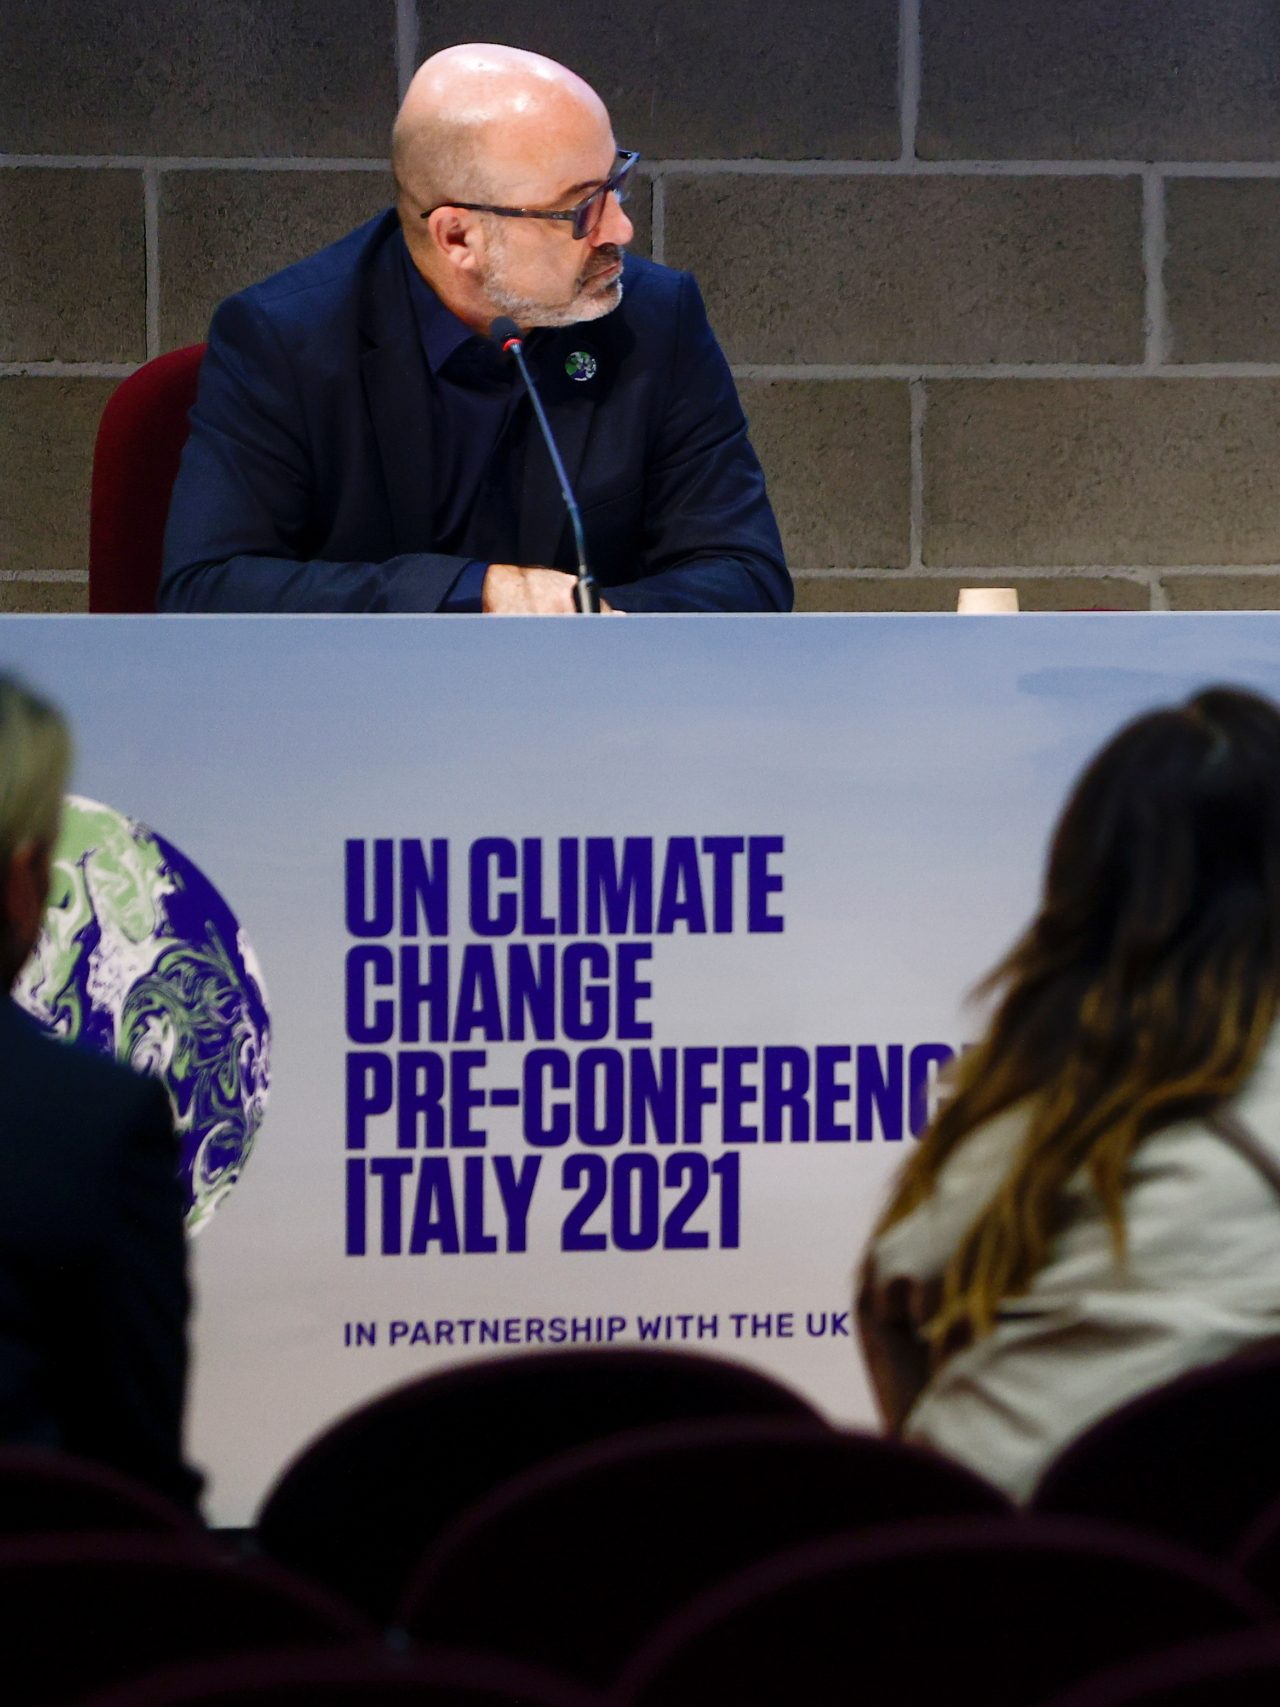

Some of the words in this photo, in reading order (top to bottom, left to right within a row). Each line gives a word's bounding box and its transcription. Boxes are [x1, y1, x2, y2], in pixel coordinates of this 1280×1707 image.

[345, 838, 450, 938] UN
[468, 836, 785, 937] CLIMATE
[345, 942, 653, 1045] CHANGE
[345, 1044, 978, 1150] PRE-CONFERENC
[345, 1155, 543, 1256] ITALY
[561, 1151, 740, 1252] 2021
[344, 1322, 376, 1346] IN
[389, 1317, 627, 1345] PARTNERSHIP
[637, 1314, 718, 1340] WITH
[729, 1313, 794, 1338] THE
[806, 1312, 849, 1337] UK
